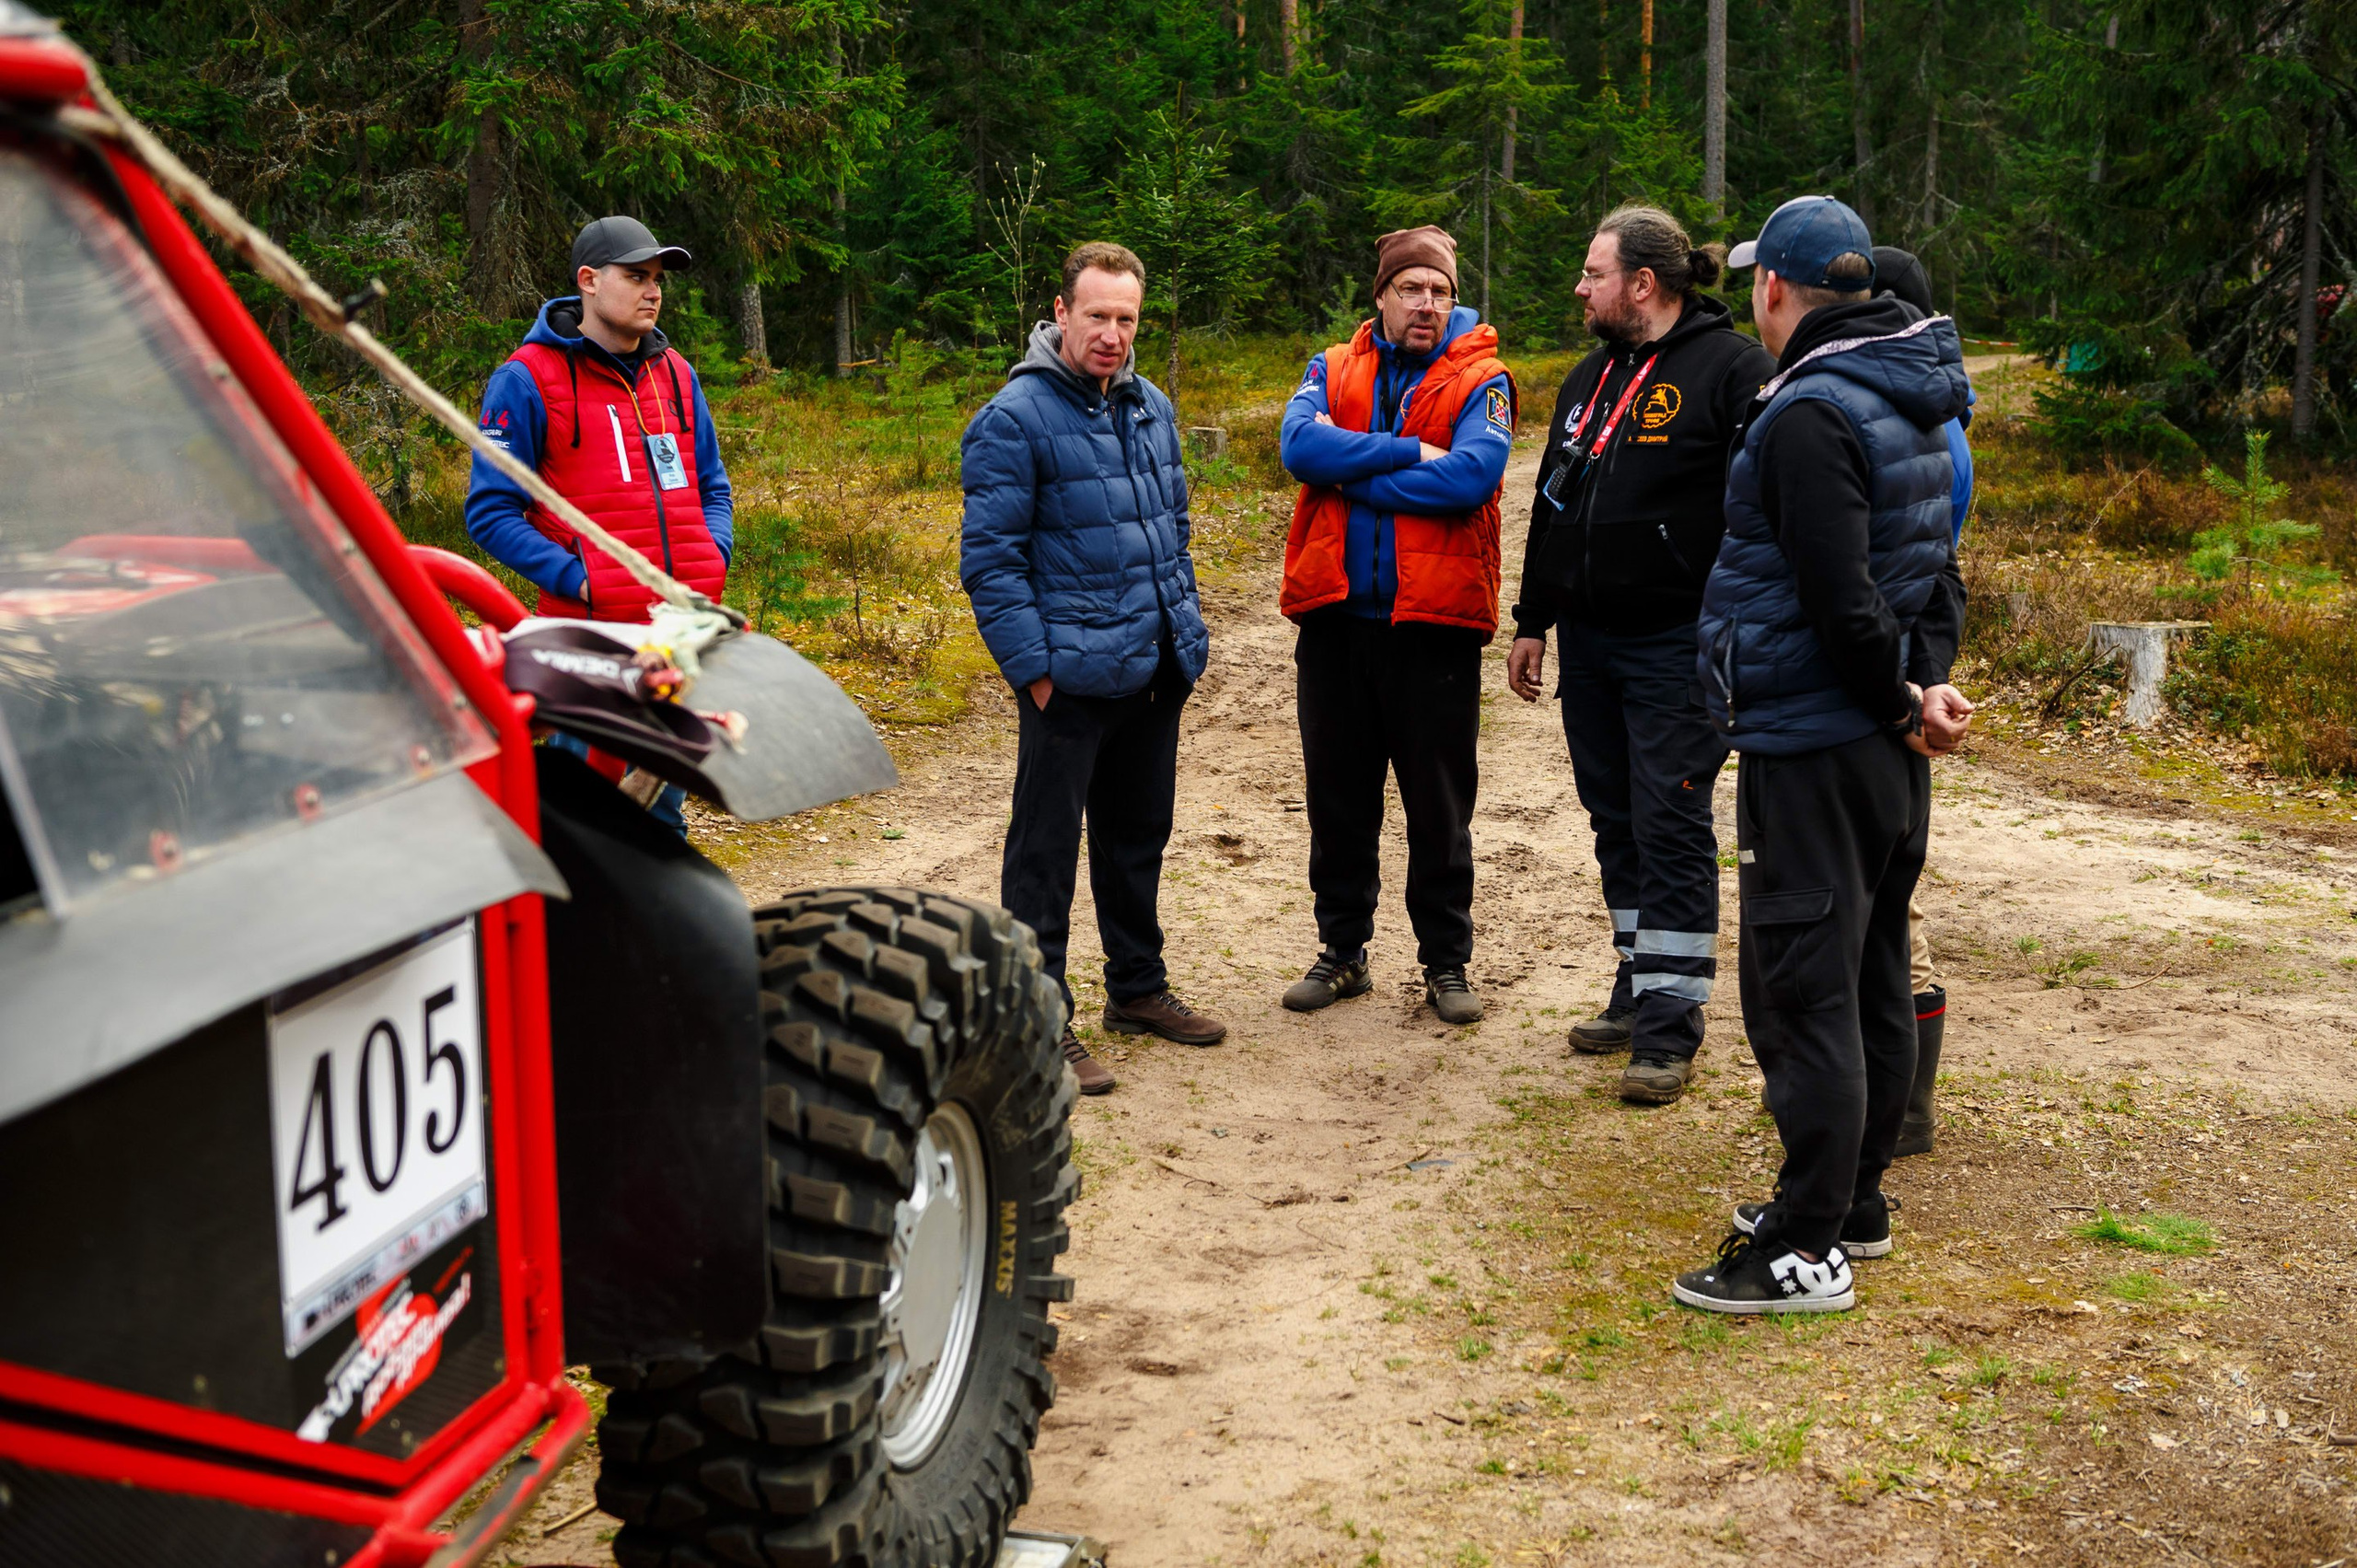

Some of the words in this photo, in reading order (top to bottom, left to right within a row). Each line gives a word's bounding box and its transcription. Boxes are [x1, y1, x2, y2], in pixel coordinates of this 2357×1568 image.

[481, 409, 509, 429] 4X4
[289, 983, 467, 1232] 405
[995, 1201, 1017, 1294] MAXXIS
